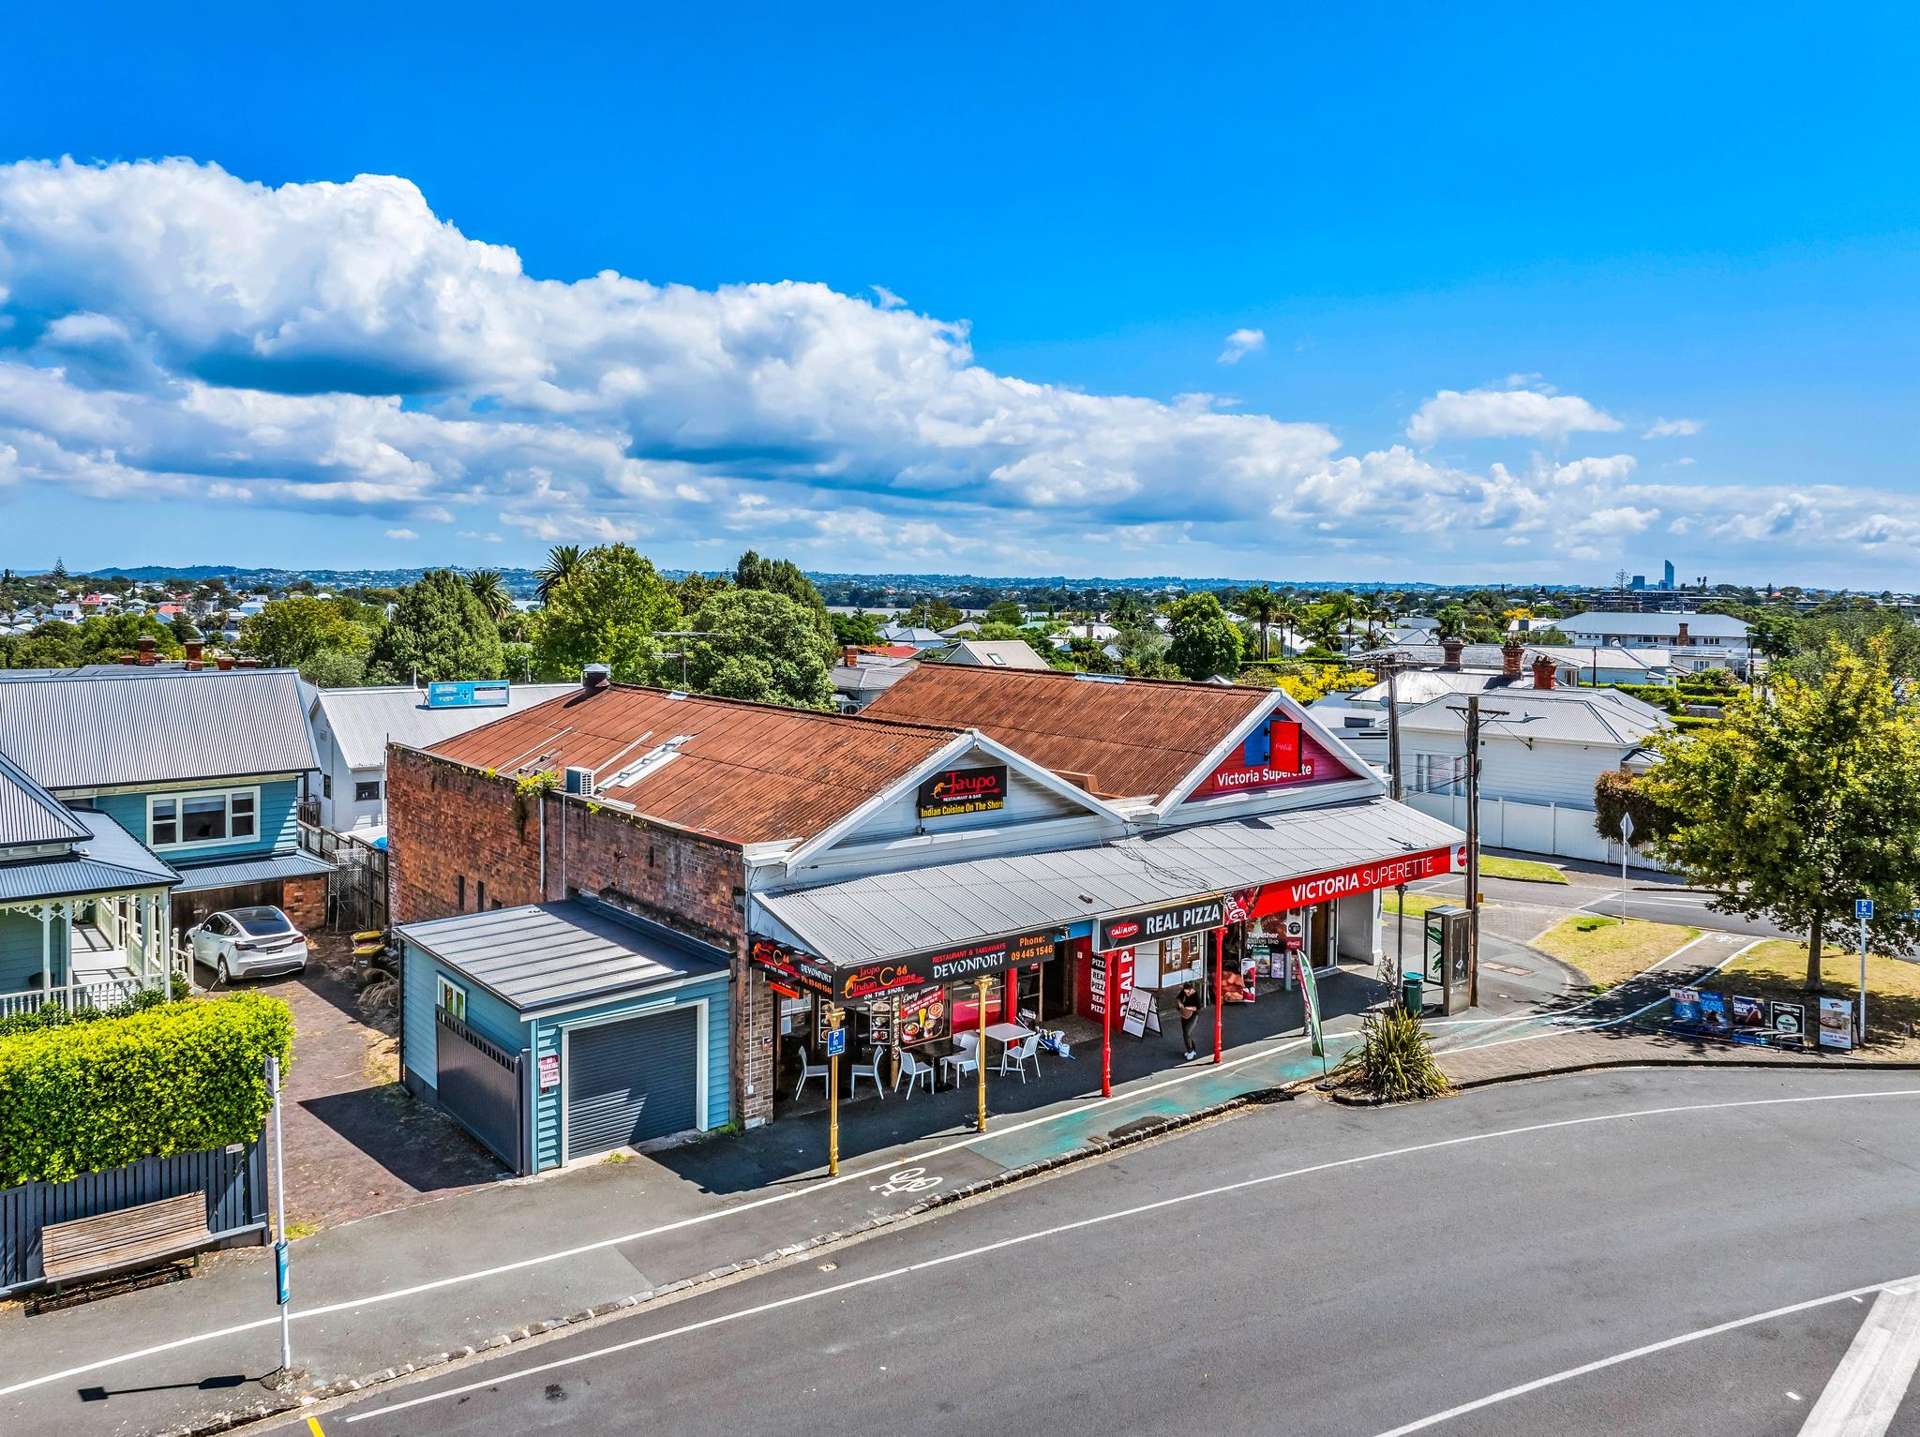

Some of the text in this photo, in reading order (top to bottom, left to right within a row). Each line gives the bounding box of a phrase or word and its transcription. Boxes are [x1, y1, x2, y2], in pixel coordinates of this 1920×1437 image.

[945, 772, 996, 795] Taupo
[1217, 763, 1312, 786] Victoria Superte
[921, 807, 941, 817] Indian
[942, 805, 965, 815] Cuisine
[965, 803, 975, 812] On
[975, 801, 986, 811] The
[1291, 856, 1433, 903] VICTORIA SUPERETTE
[1146, 912, 1180, 935] REAL
[1183, 904, 1220, 927] PIZZA
[1011, 944, 1053, 961] 09 445 1546
[1019, 935, 1045, 947] Phone:
[932, 950, 967, 963] RESTAURANT
[933, 951, 1006, 979] DEVONPORT
